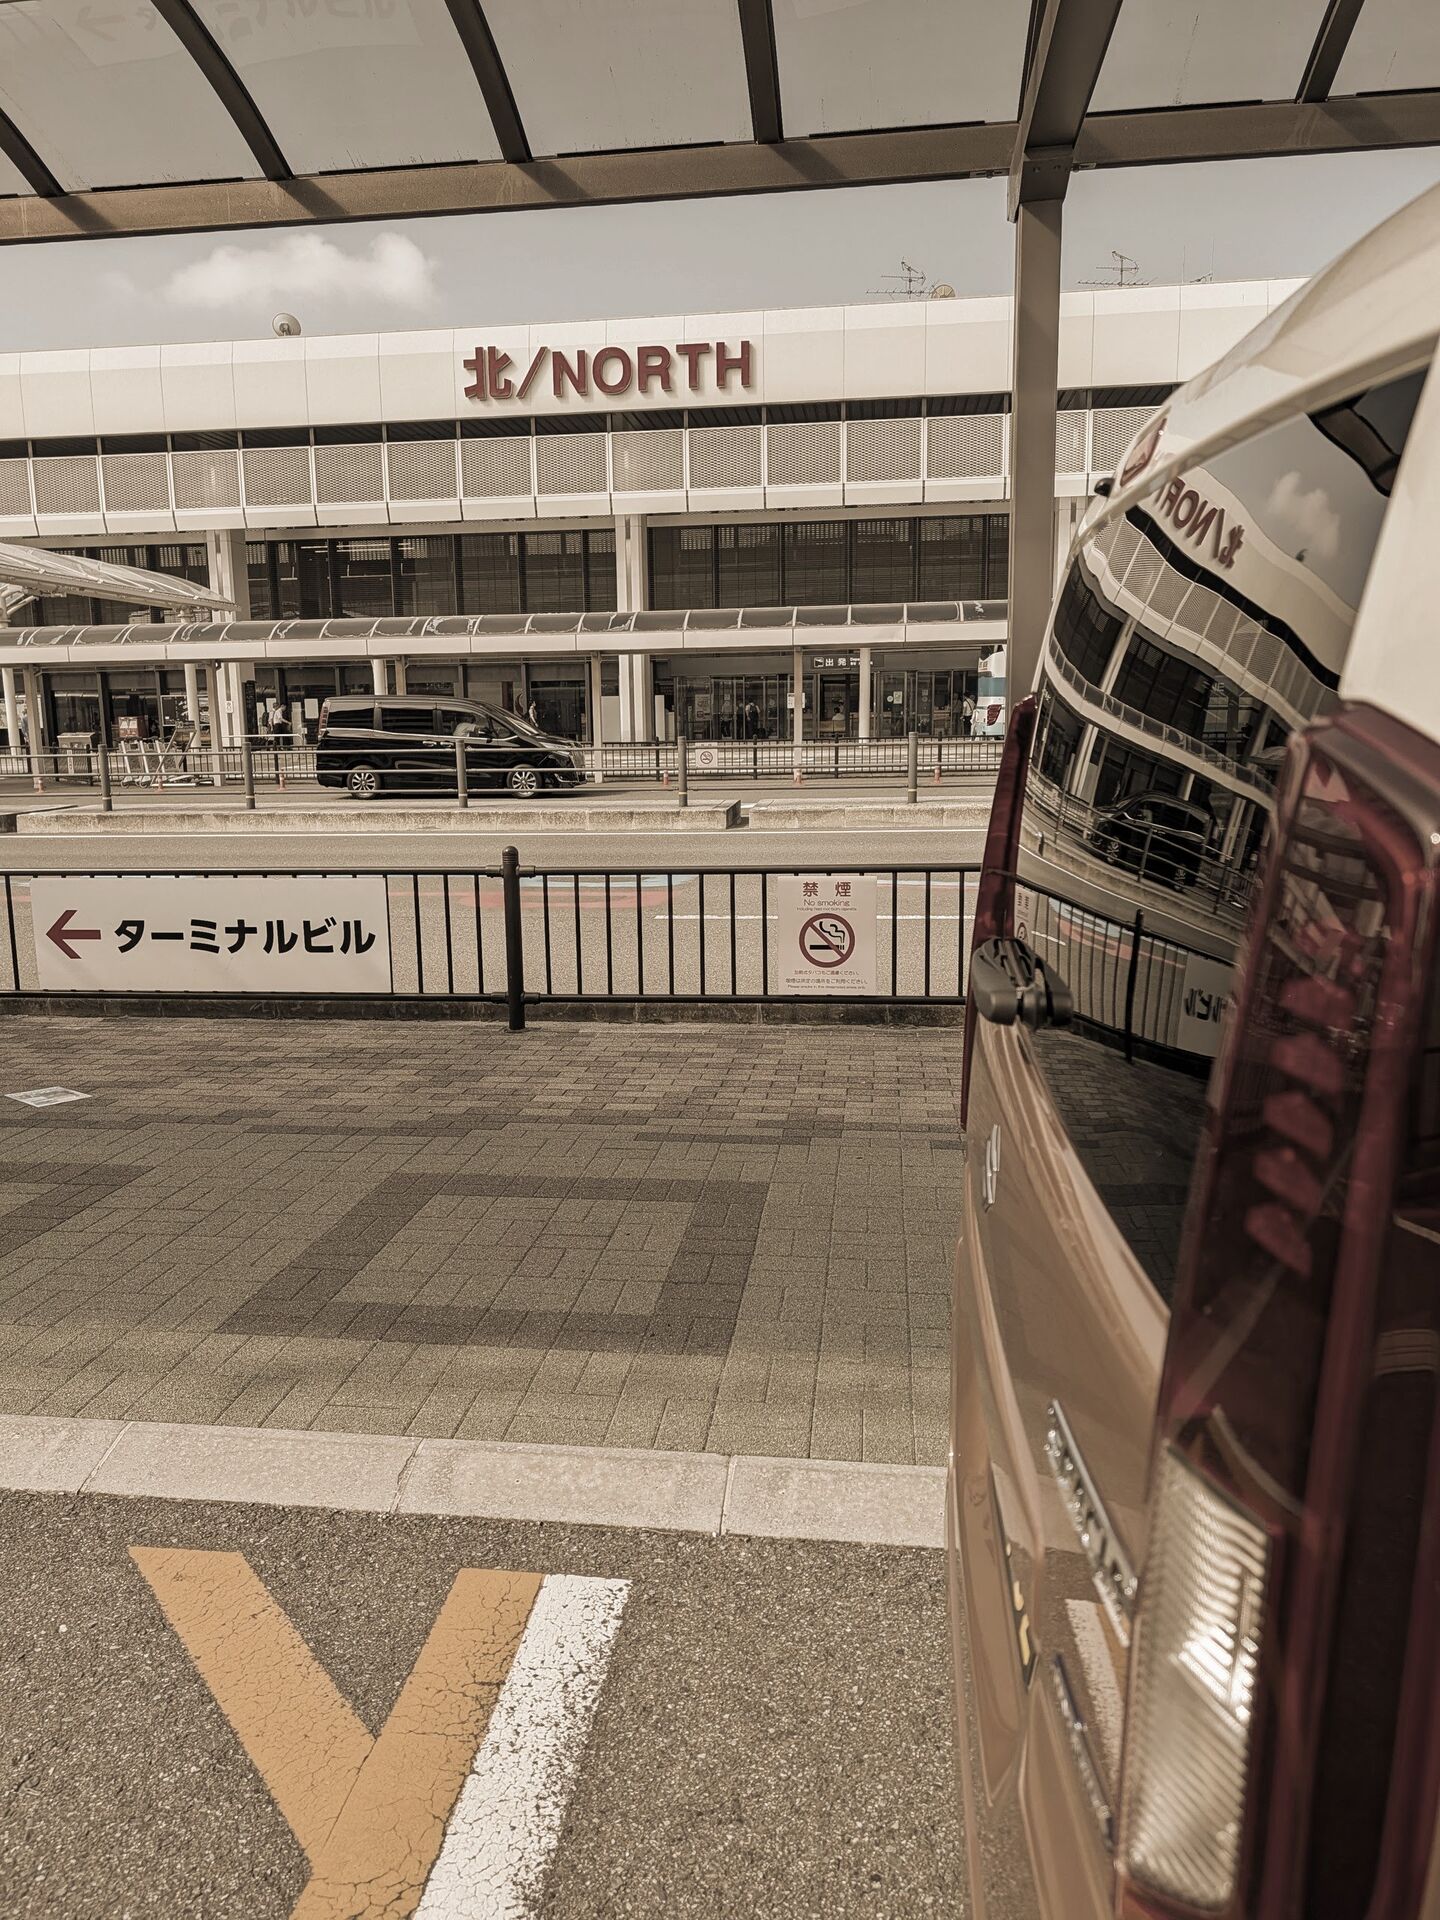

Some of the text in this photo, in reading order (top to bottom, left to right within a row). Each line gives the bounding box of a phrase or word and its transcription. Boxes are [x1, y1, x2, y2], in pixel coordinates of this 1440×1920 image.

[463, 340, 751, 400] 北/NORTH
[803, 881, 851, 897] 禁煙
[803, 899, 850, 907] No smoking
[114, 917, 376, 955] ターミナルビル
